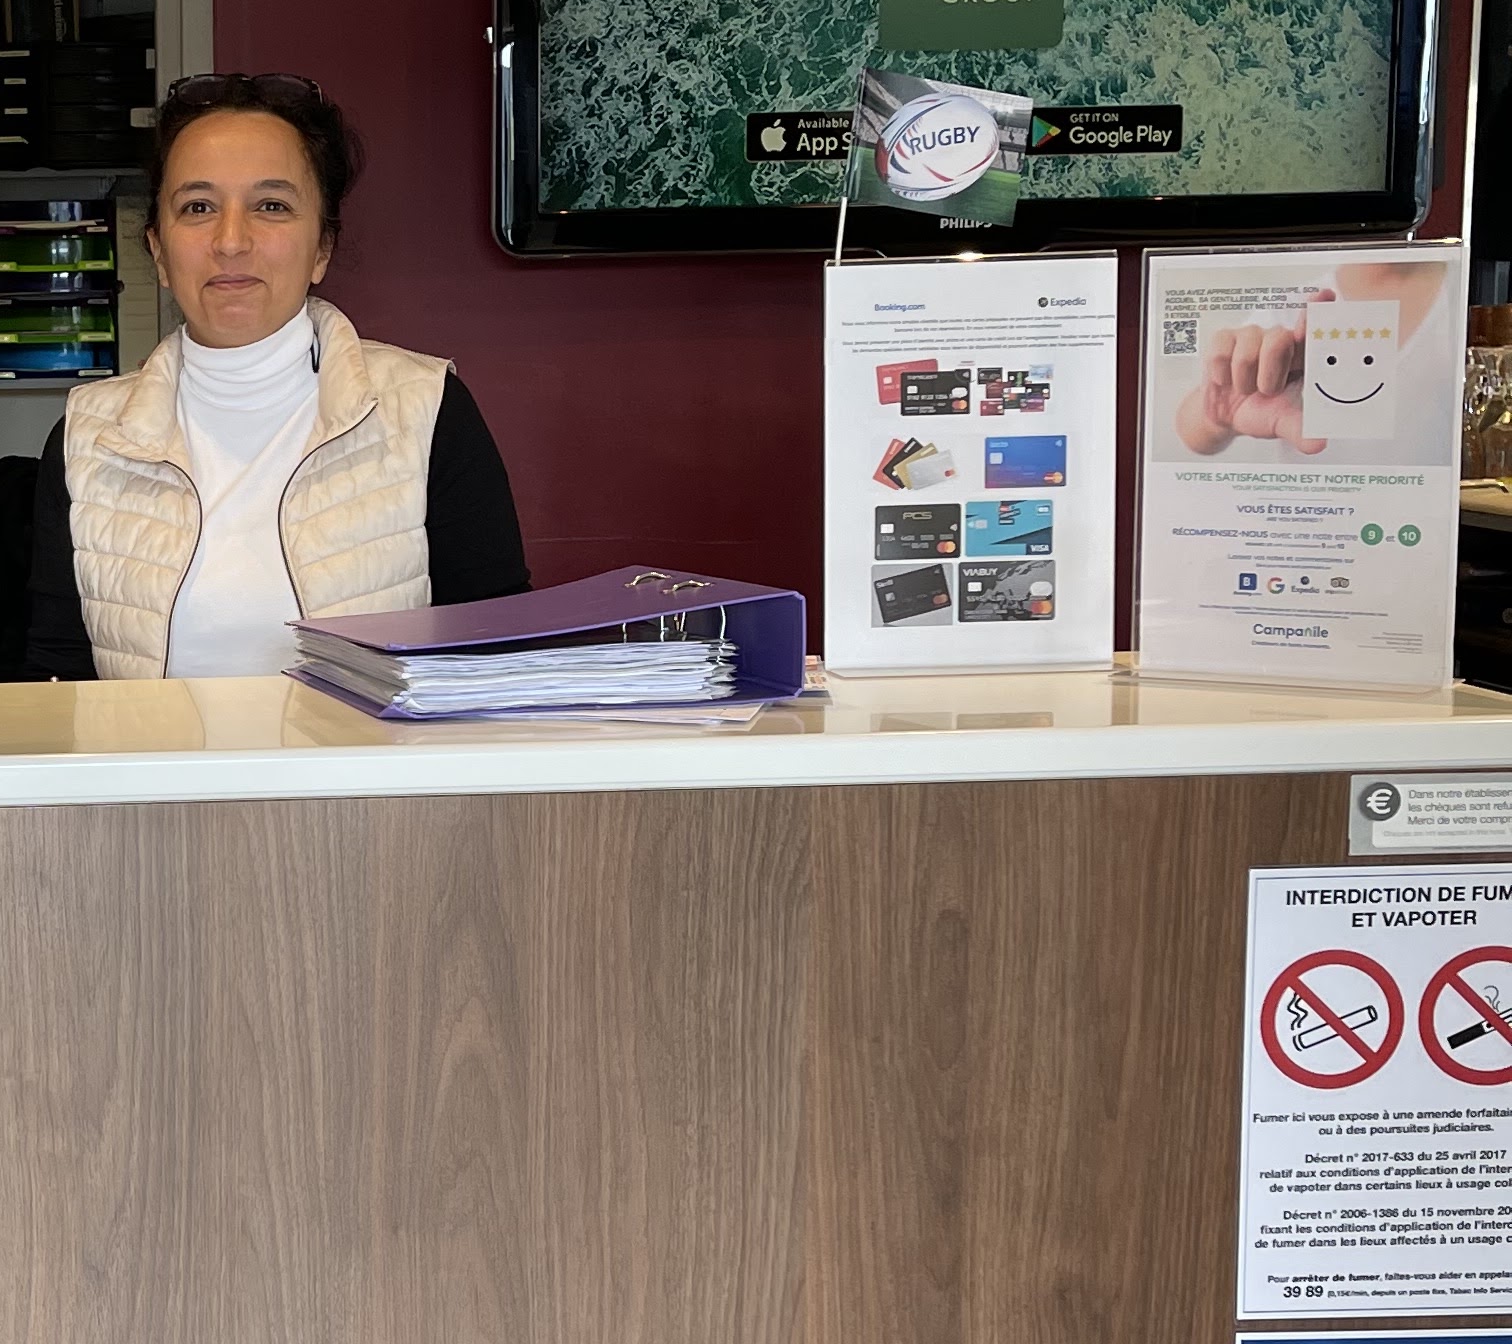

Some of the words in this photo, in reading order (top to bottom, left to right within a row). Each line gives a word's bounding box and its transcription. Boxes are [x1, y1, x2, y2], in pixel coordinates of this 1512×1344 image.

[797, 118, 849, 128] Available
[1069, 113, 1089, 123] GET
[1091, 113, 1099, 123] IT
[1102, 113, 1119, 123] ON
[910, 126, 980, 156] RUGBY
[1068, 126, 1133, 148] Google
[1137, 124, 1173, 146] Play
[796, 135, 834, 155] App
[874, 303, 925, 312] Booking.com
[1051, 297, 1087, 307] Expedia
[1176, 472, 1213, 482] VOTRE
[1215, 472, 1296, 483] SATISFACTION
[1300, 475, 1322, 483] EST
[1325, 475, 1365, 484] NOTRE
[1368, 474, 1425, 486] PRIORITÉ
[1237, 505, 1265, 514] VOUS
[1268, 504, 1292, 514] ÊTES
[1295, 506, 1345, 515] SATISFAIT
[1172, 528, 1268, 538] RÉCOMPENSEZ-NOUS
[1401, 531, 1417, 541] 10
[963, 568, 998, 576] VIABUY
[1253, 623, 1329, 639] Campanile
[1408, 790, 1434, 799] Dans
[1437, 790, 1462, 798] notre
[1408, 803, 1422, 812] les
[1425, 803, 1466, 812] chèques
[1469, 802, 1490, 811] sont
[1408, 816, 1435, 824] Merci
[1437, 816, 1450, 824] de
[1453, 816, 1477, 824] votre
[1286, 887, 1432, 905] INTERDICTION
[1438, 886, 1465, 902] DE
[1352, 913, 1377, 927] ET
[1382, 910, 1477, 927] VAPOTER
[1253, 1113, 1290, 1122] Fumer
[1292, 1112, 1305, 1121] ici
[1338, 1113, 1379, 1122] expose
[1383, 1110, 1389, 1119] à
[1417, 1109, 1463, 1119] amende
[1319, 1127, 1333, 1135] ou
[1336, 1125, 1342, 1134] à
[1346, 1126, 1366, 1134] des
[1370, 1124, 1429, 1136] poursuites
[1432, 1122, 1494, 1134] judiciaires.
[1305, 1153, 1343, 1163] Décret
[1362, 1152, 1414, 1162] 2017-633
[1417, 1152, 1432, 1161] du
[1435, 1151, 1449, 1160] 25
[1452, 1151, 1476, 1160] avril
[1480, 1150, 1506, 1159] 2017
[1259, 1169, 1293, 1178] relatif
[1320, 1168, 1380, 1177] conditions
[1384, 1166, 1458, 1177] d'application
[1461, 1165, 1475, 1174] de
[1283, 1286, 1301, 1298] 39
[1306, 1286, 1323, 1297] 89
